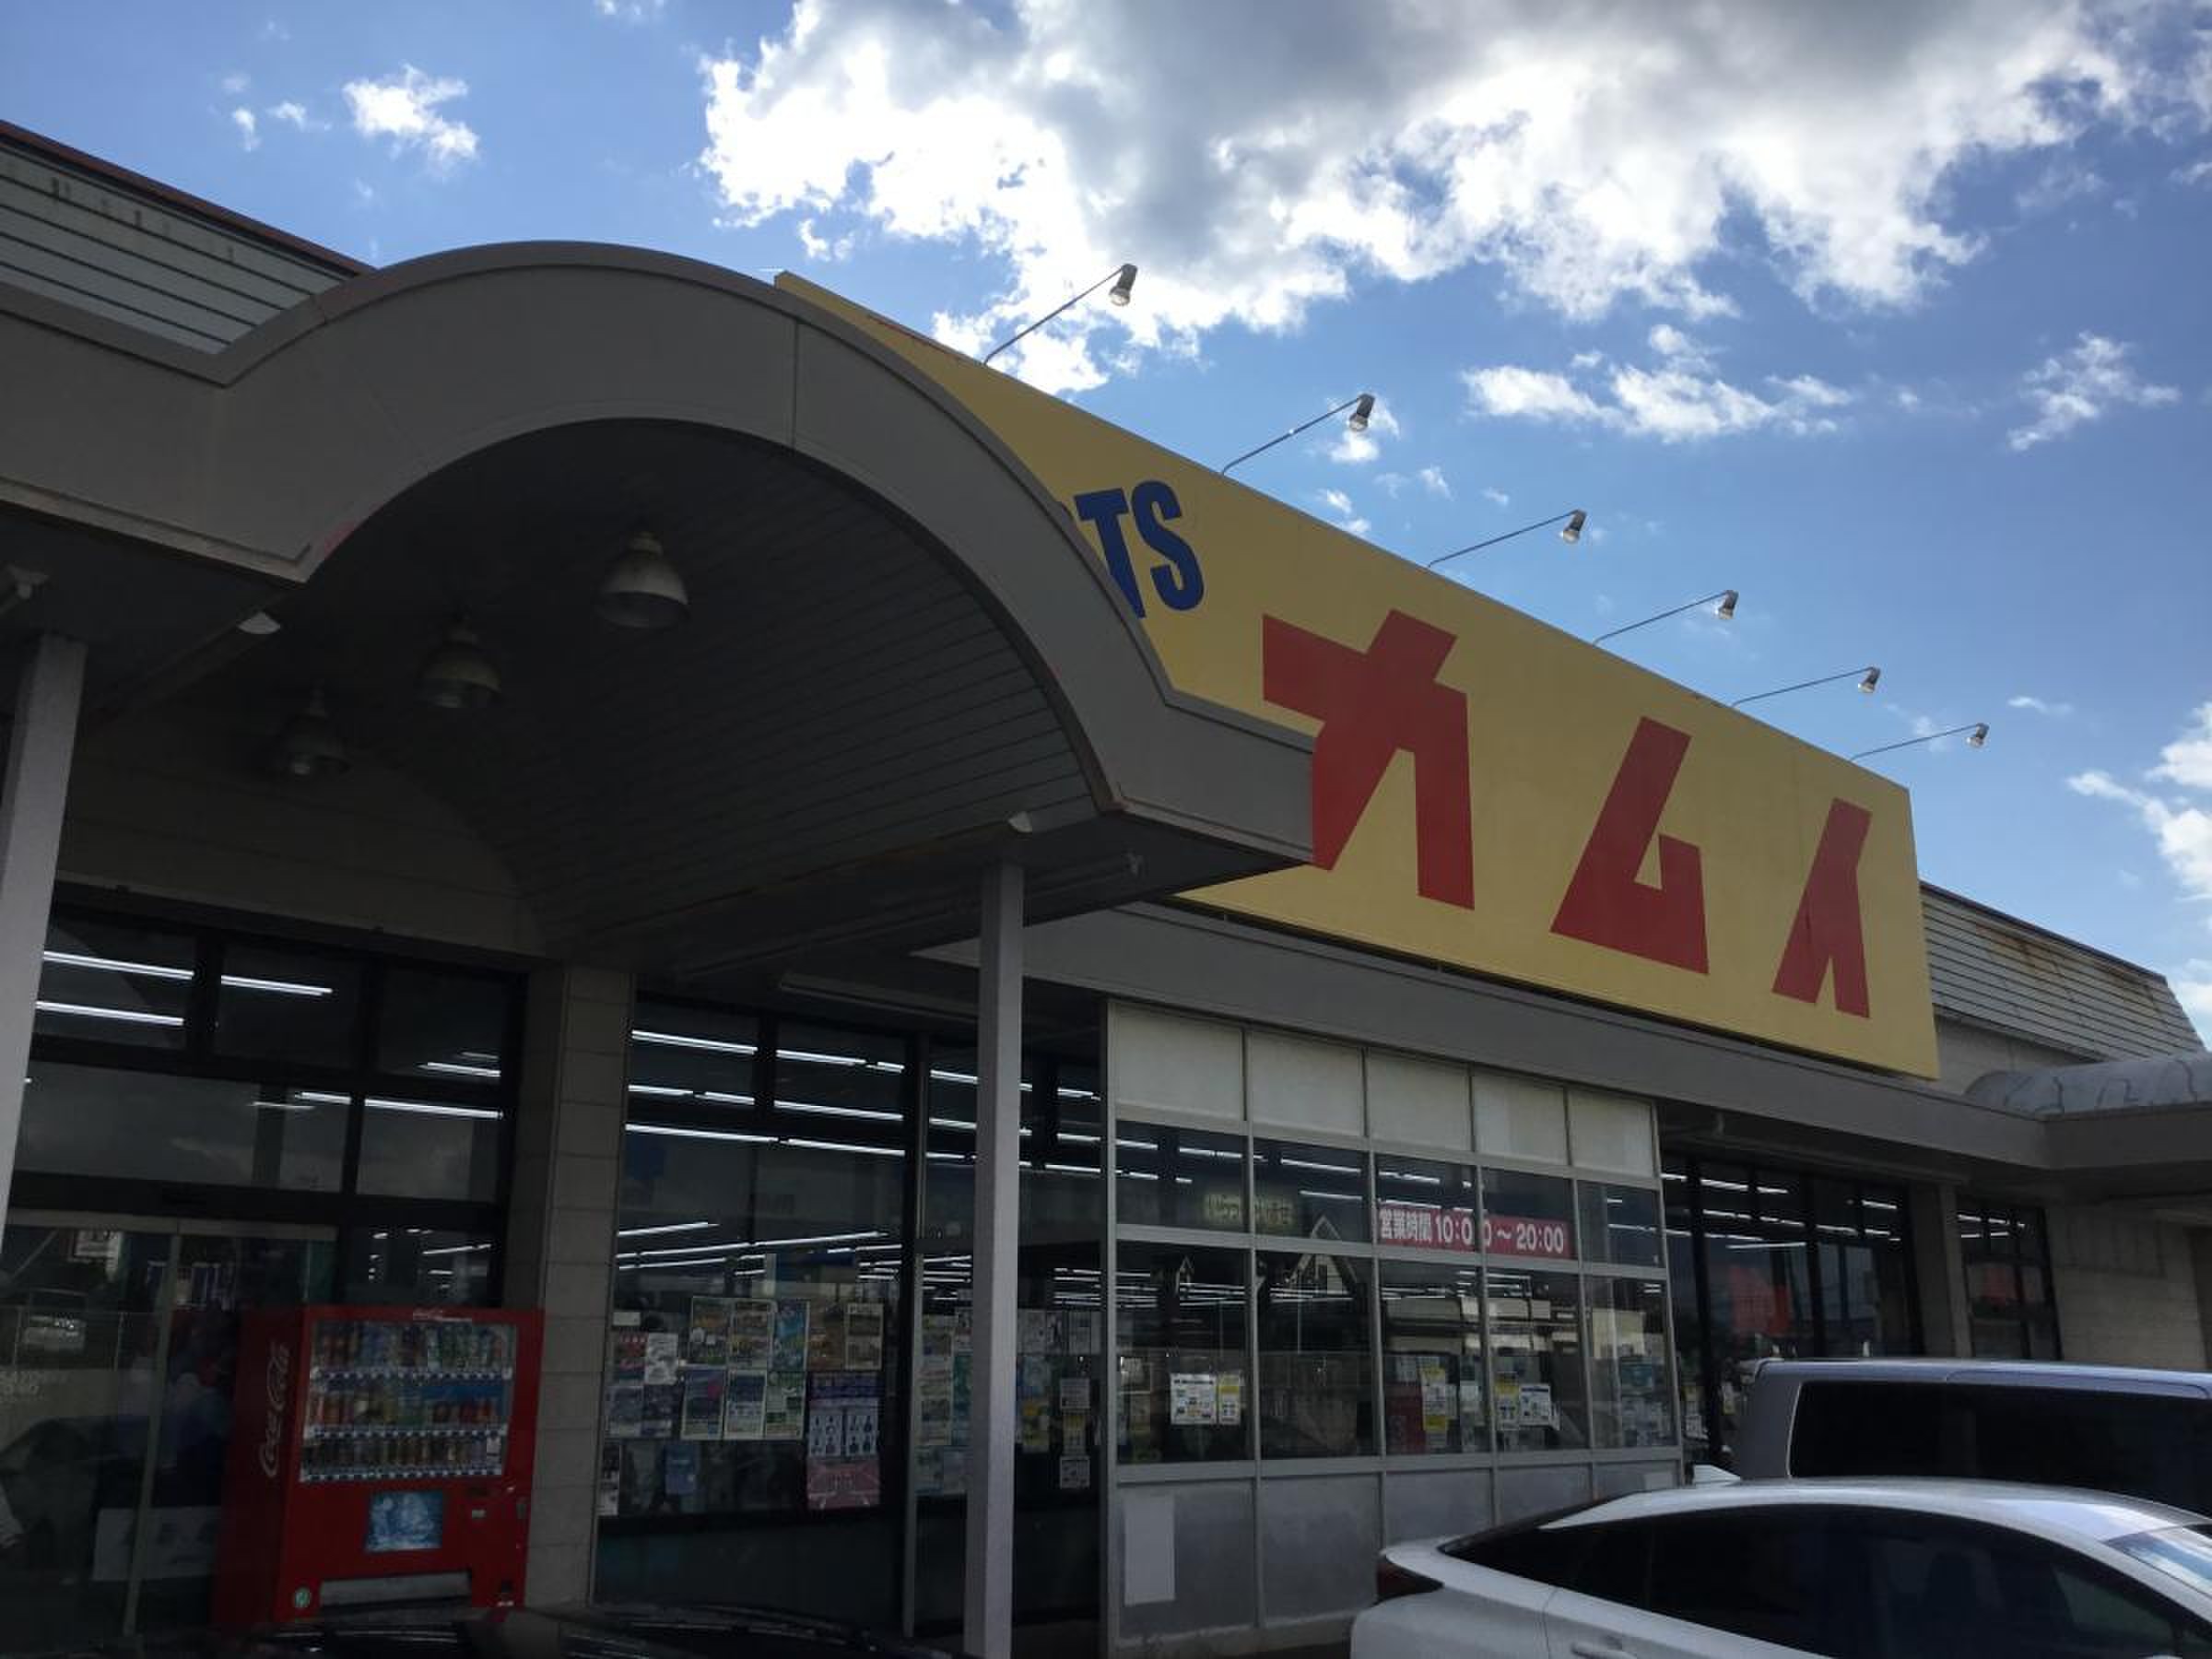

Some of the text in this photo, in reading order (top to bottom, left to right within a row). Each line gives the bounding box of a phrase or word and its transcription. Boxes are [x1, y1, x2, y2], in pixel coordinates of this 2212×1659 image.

[1061, 480, 1205, 618] TS
[1263, 609, 1872, 1019] カムイ
